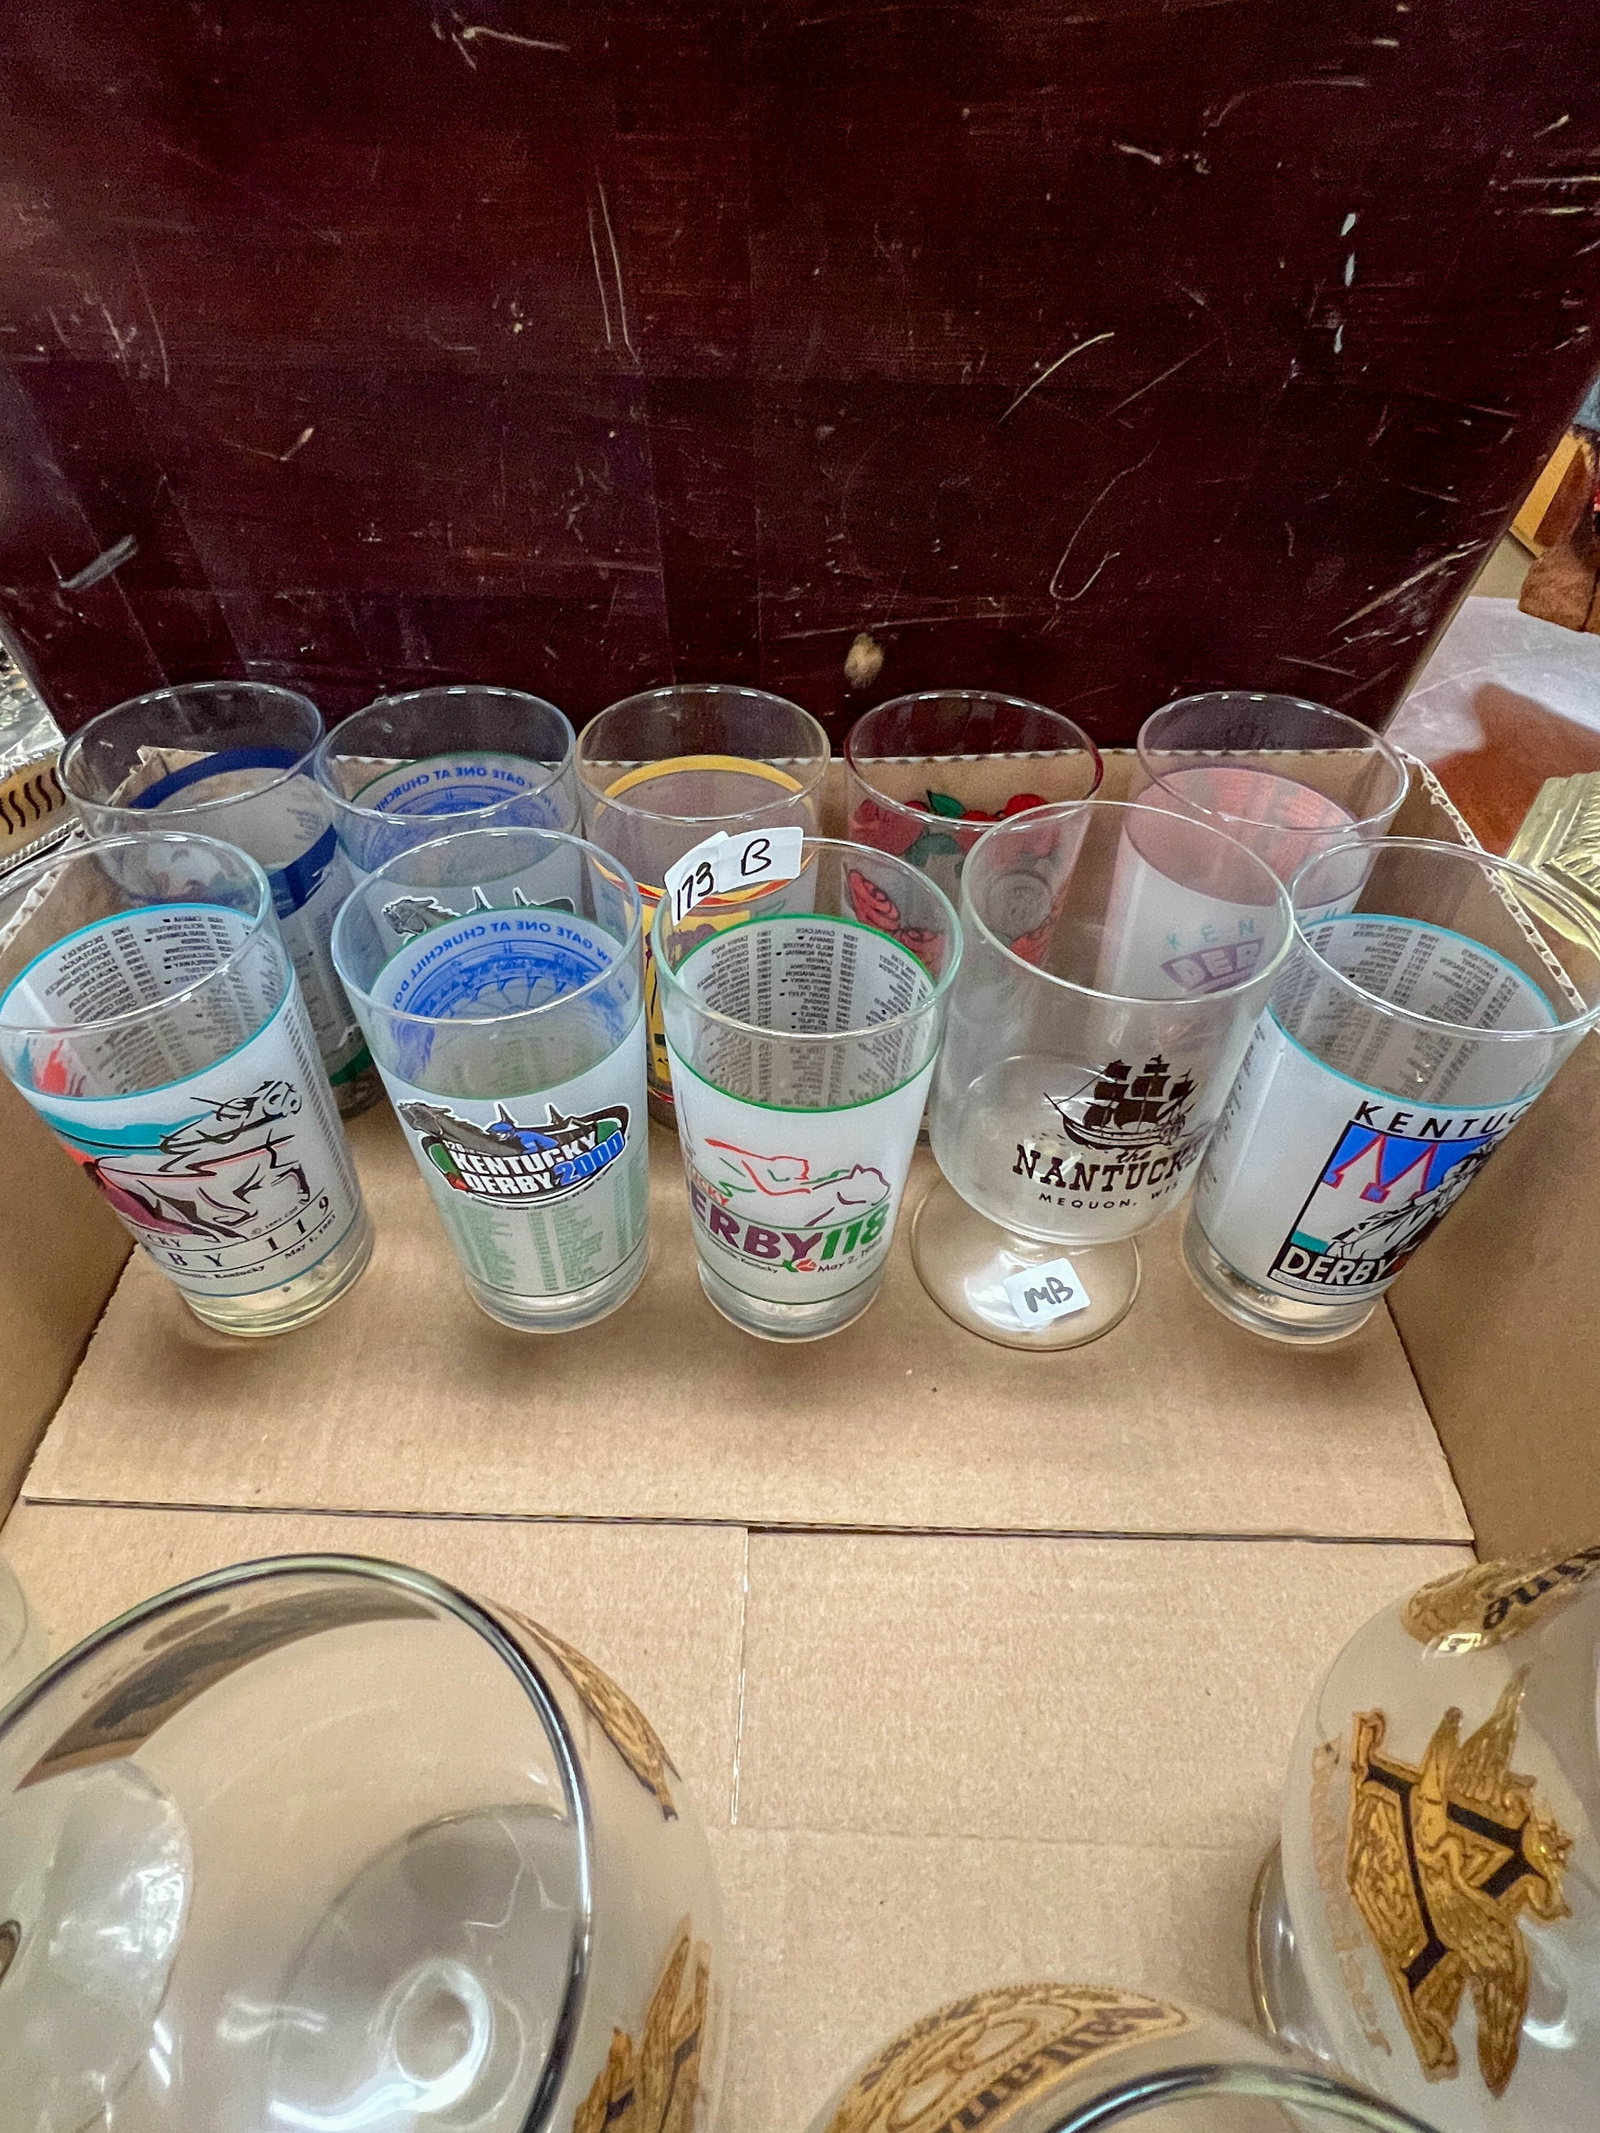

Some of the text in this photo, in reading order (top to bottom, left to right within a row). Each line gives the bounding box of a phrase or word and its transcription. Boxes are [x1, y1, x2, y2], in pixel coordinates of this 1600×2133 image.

[740, 838, 772, 877] B
[677, 861, 715, 921] 173
[449, 1130, 597, 1176] KENTUCKY
[461, 1171, 554, 1195] DERBY
[553, 1130, 625, 1187] 2000
[1013, 1142, 1195, 1192] NANTUCK
[1115, 1149, 1153, 1164] the
[264, 1196, 330, 1252] 119
[819, 1203, 890, 1262] 118
[214, 1264, 265, 1279] Kentucky
[284, 1243, 306, 1260] May
[740, 1257, 778, 1275] Kentucky
[817, 1261, 846, 1274] May
[1279, 1245, 1400, 1286] DERBY
